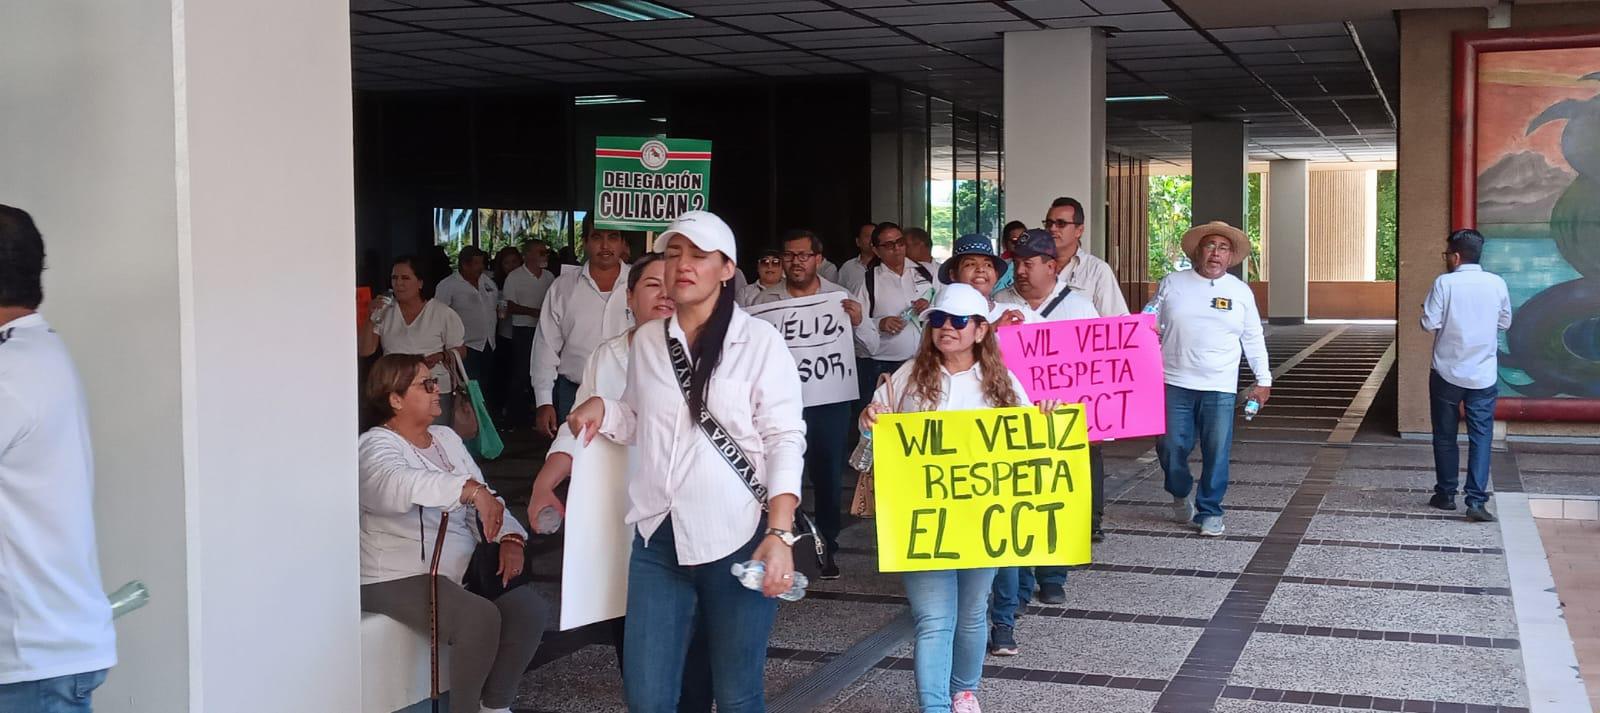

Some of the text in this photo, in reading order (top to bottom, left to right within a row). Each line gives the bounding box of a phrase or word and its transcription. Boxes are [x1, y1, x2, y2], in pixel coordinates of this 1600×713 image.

[603, 170, 703, 190] DELEGACIÓN
[599, 190, 688, 220] CULIACAN
[1017, 321, 1139, 358] WIL VELIZ
[1029, 358, 1135, 391] RESPETA
[895, 408, 1086, 457] WIL VELIZ
[922, 457, 1074, 500] RESPETA
[907, 501, 1065, 560] EL CCT
